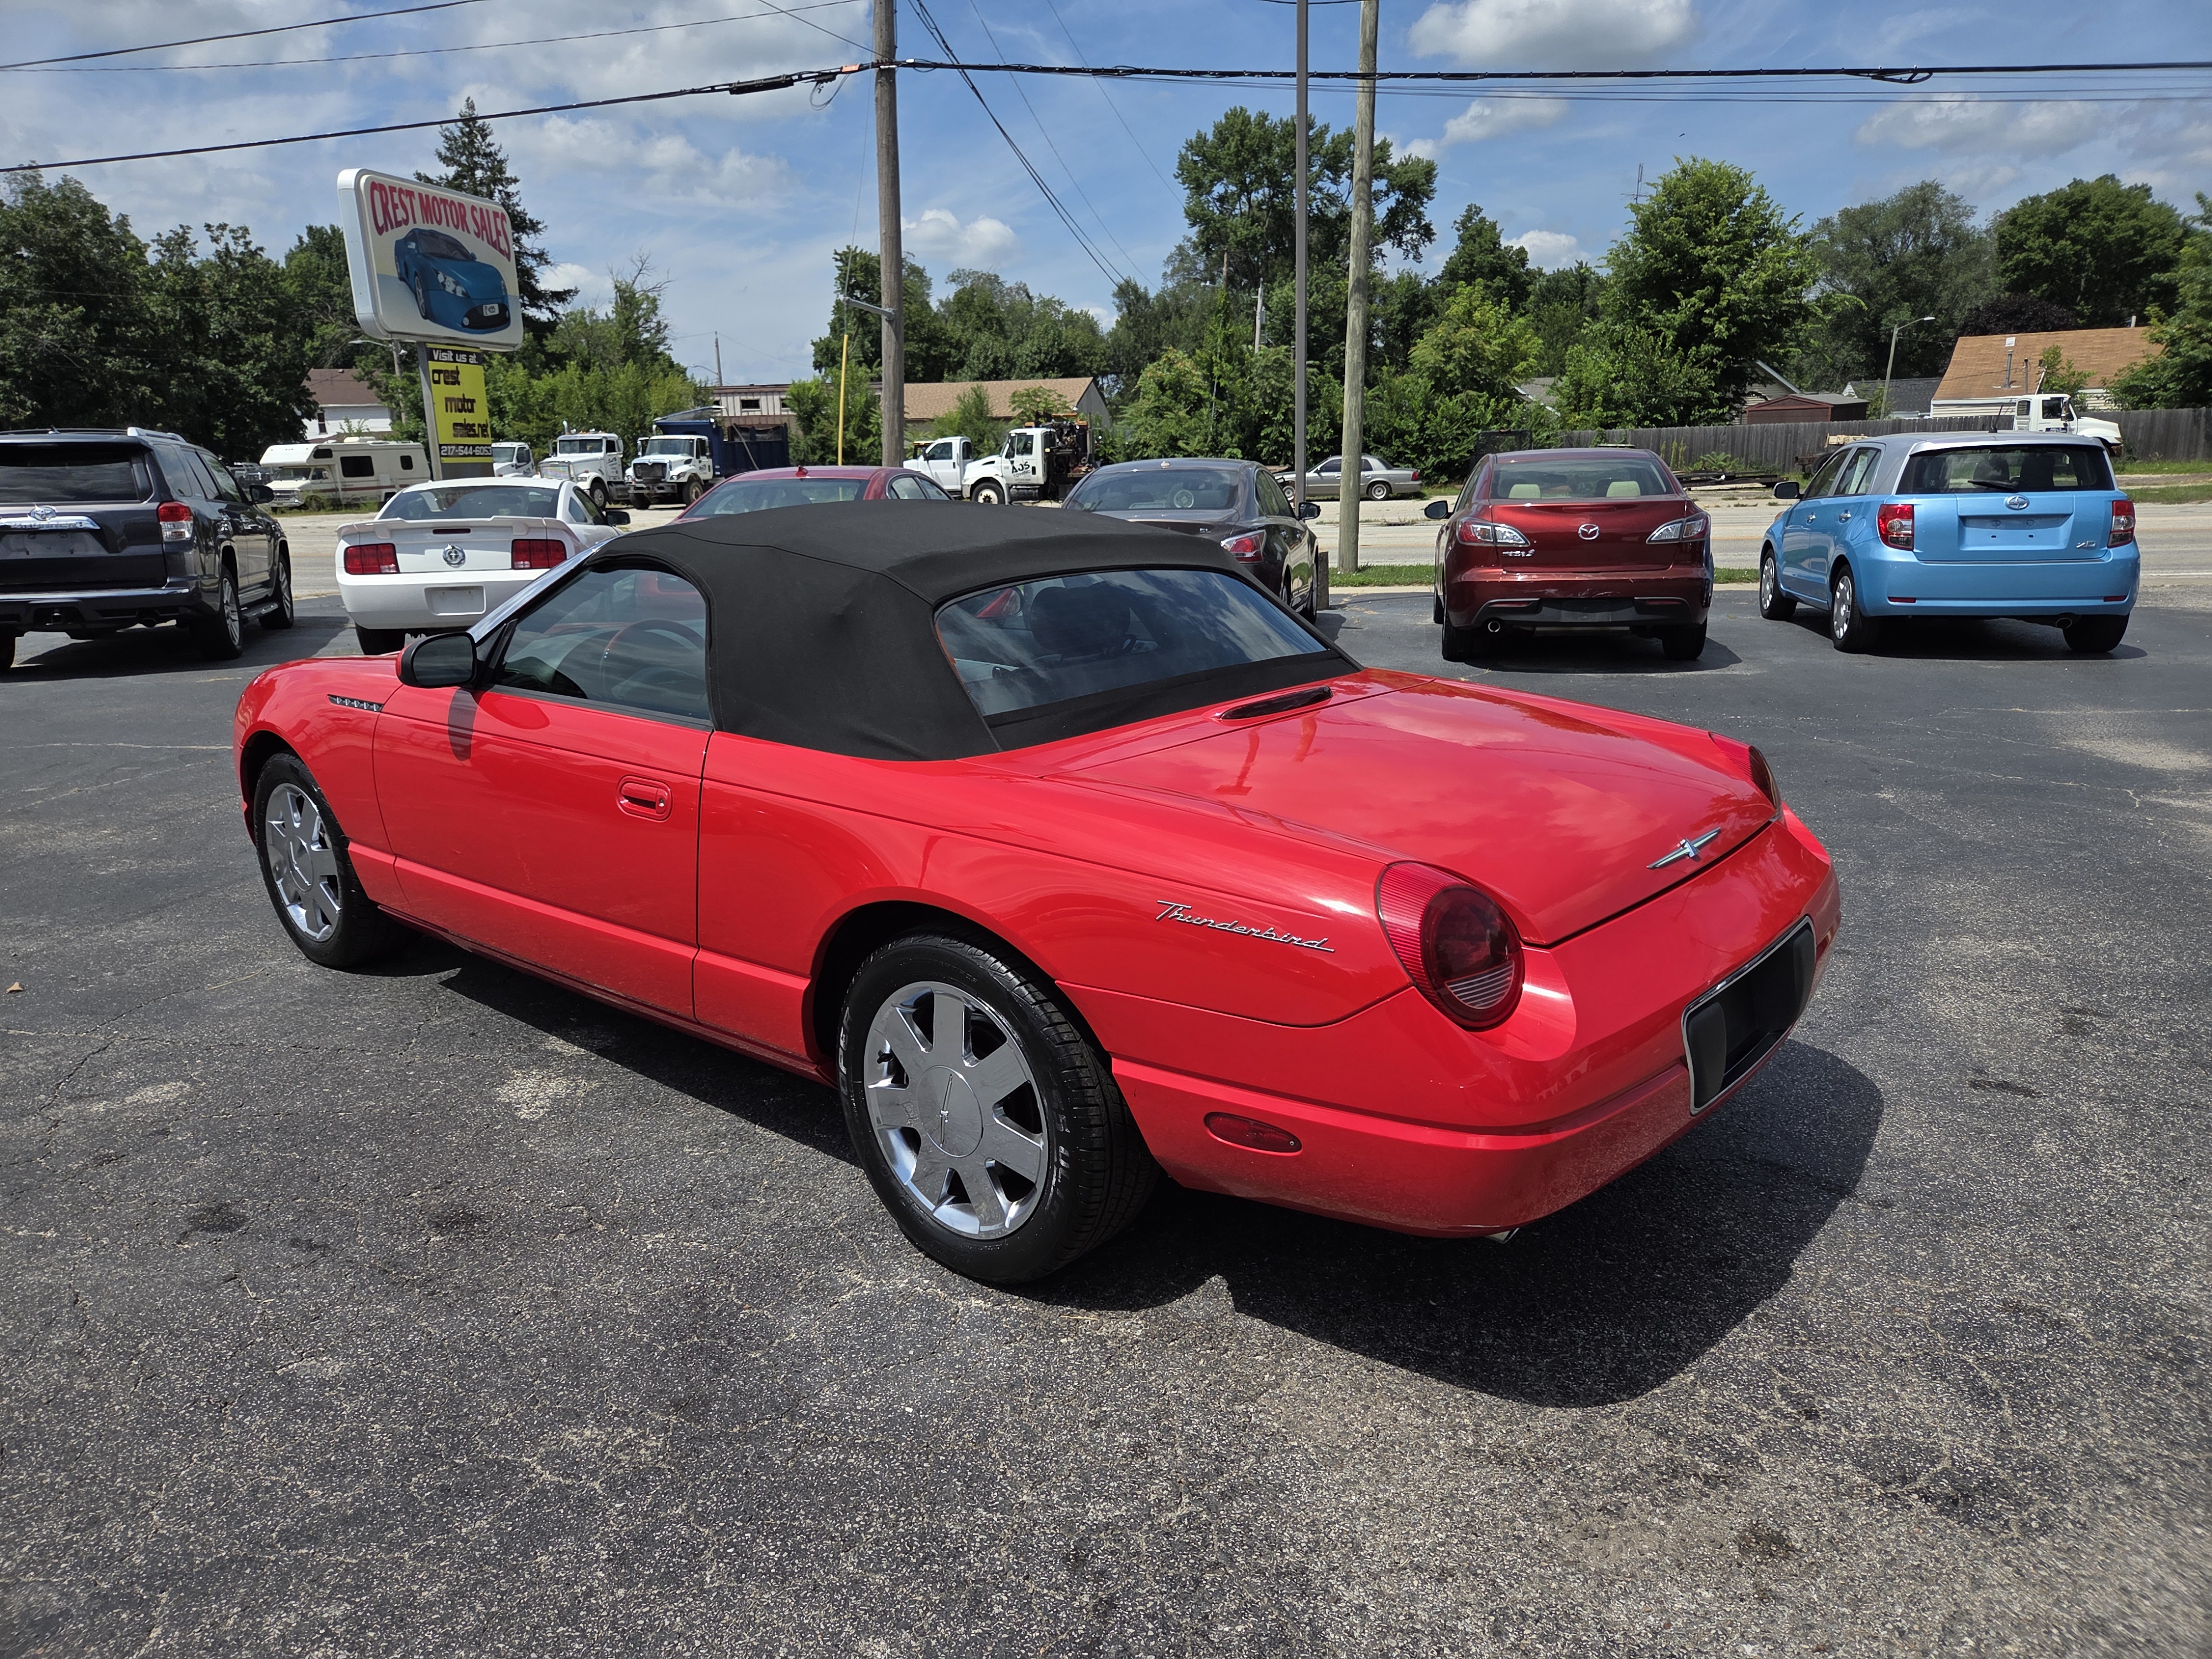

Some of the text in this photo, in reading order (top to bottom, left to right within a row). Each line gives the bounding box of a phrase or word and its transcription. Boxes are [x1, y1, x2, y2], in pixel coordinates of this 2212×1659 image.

[370, 181, 511, 262] CREST MOTOR SALES
[432, 349, 478, 364] Visit us at
[432, 366, 461, 386] crest
[445, 393, 476, 414] motor
[452, 418, 489, 438] sales.net
[441, 446, 492, 456] 217-544-6053
[1011, 461, 1030, 474] AJS
[1156, 900, 1335, 952] Thunderbird
